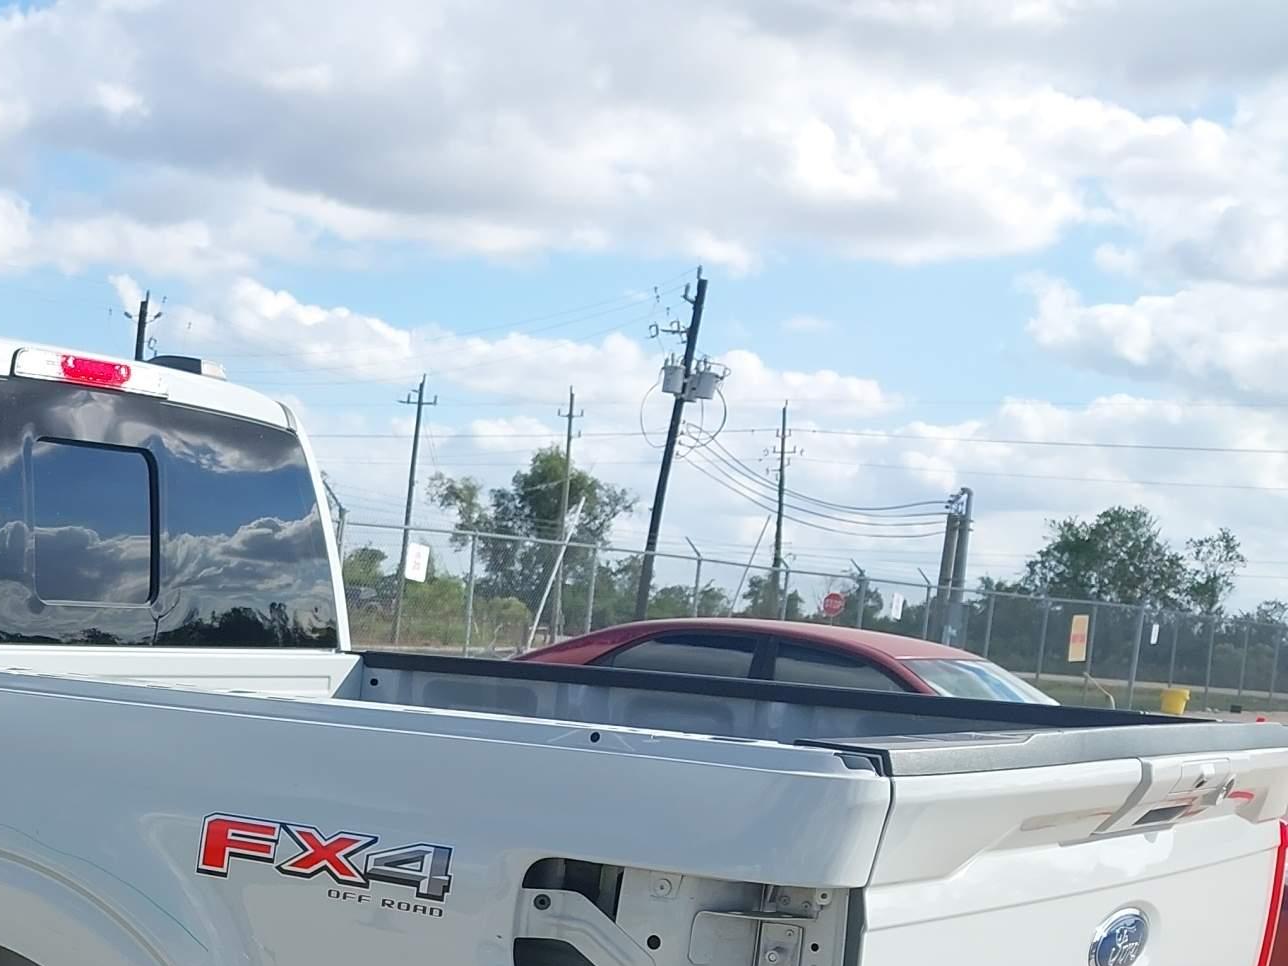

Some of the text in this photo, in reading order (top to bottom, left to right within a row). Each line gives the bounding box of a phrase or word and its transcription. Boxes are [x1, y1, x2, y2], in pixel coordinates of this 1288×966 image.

[196, 812, 453, 902] FX4
[327, 888, 444, 918] OFF ROAD
